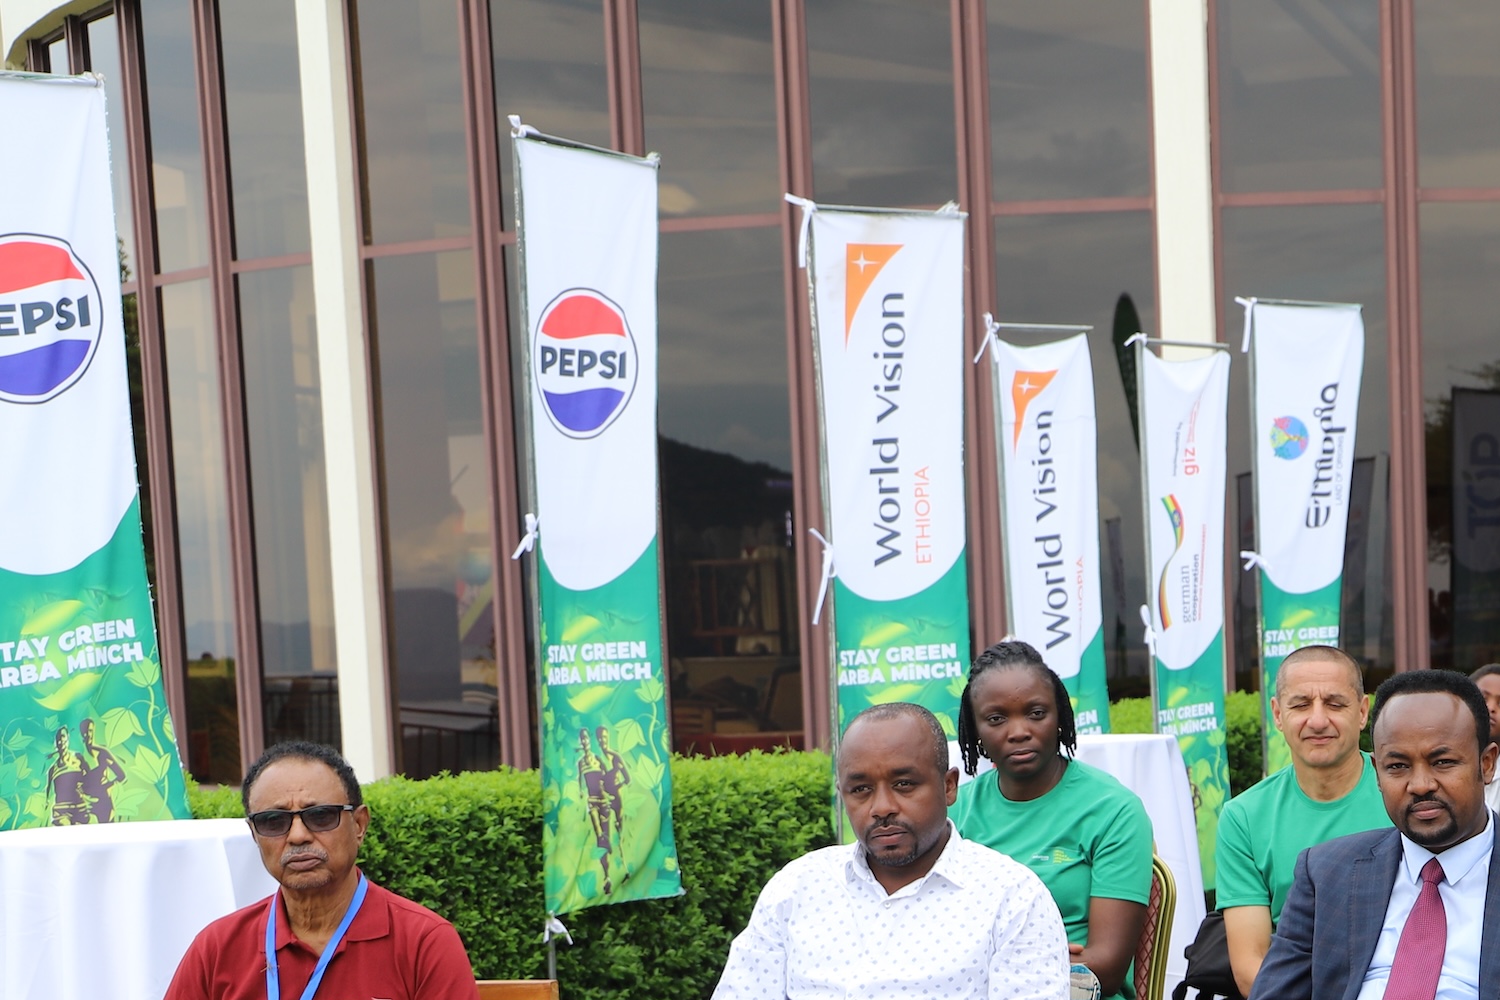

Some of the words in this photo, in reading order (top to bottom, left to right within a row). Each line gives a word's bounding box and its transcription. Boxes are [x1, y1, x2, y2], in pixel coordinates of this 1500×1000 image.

[541, 345, 627, 380] PEPSI
[873, 292, 906, 424] Vision
[1032, 410, 1058, 522] Vision
[1182, 447, 1199, 475] giz
[870, 437, 902, 567] World
[914, 466, 931, 564] ETHIOPIA
[1035, 534, 1071, 650] World
[1181, 565, 1191, 623] german
[58, 618, 136, 651] GREEN
[1265, 628, 1294, 643] STAY
[1298, 625, 1339, 639] GREE
[547, 644, 577, 663] STAY
[581, 641, 647, 661] GREEN
[840, 648, 880, 667] STAY
[885, 643, 957, 663] GREEN
[0, 661, 62, 688] RBA
[548, 666, 582, 686] ARBA
[838, 667, 886, 686] ARBA
[1177, 702, 1214, 720] GREEN
